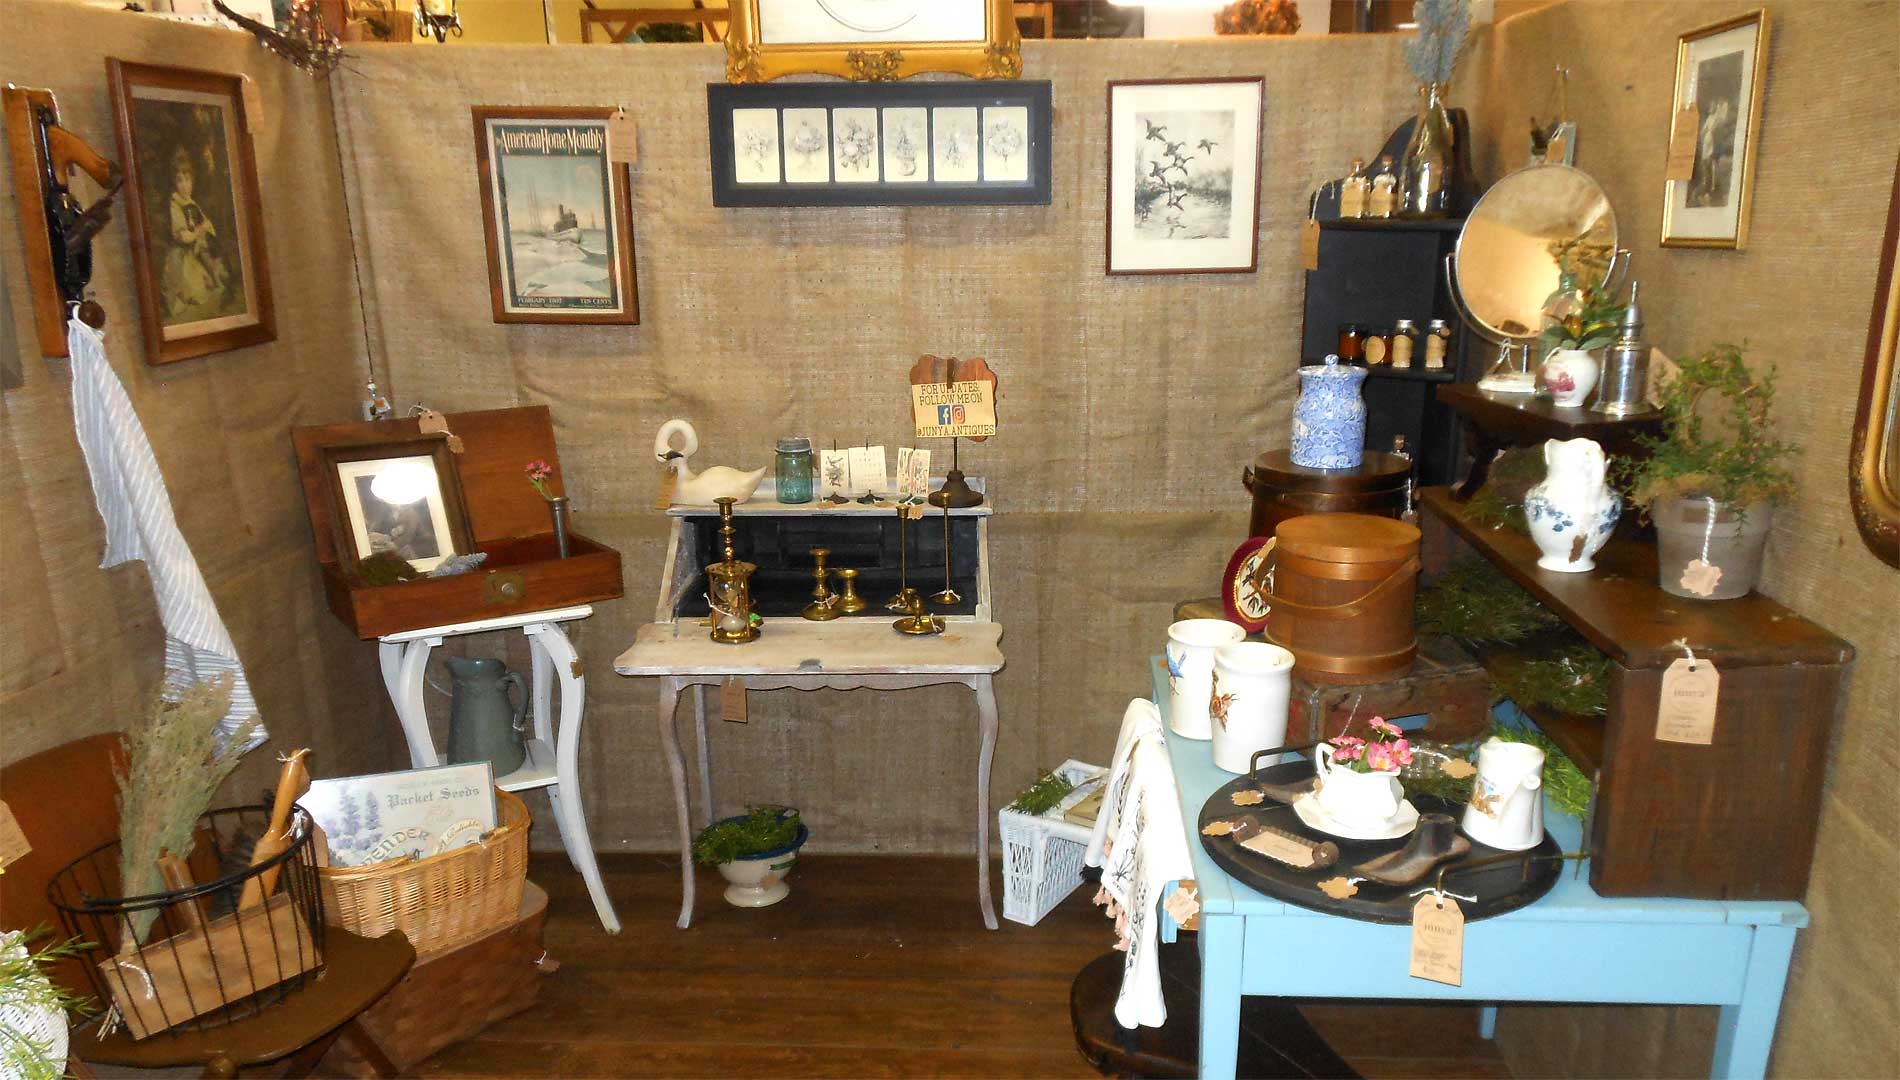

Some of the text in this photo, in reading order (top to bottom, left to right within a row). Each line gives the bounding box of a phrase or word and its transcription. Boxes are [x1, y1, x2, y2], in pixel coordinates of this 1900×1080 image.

[501, 128, 604, 154] American Home Monthly
[920, 385, 938, 395] FOR
[919, 393, 983, 406] FOLLOW ME ON
[385, 786, 479, 809] Packet Seeds
